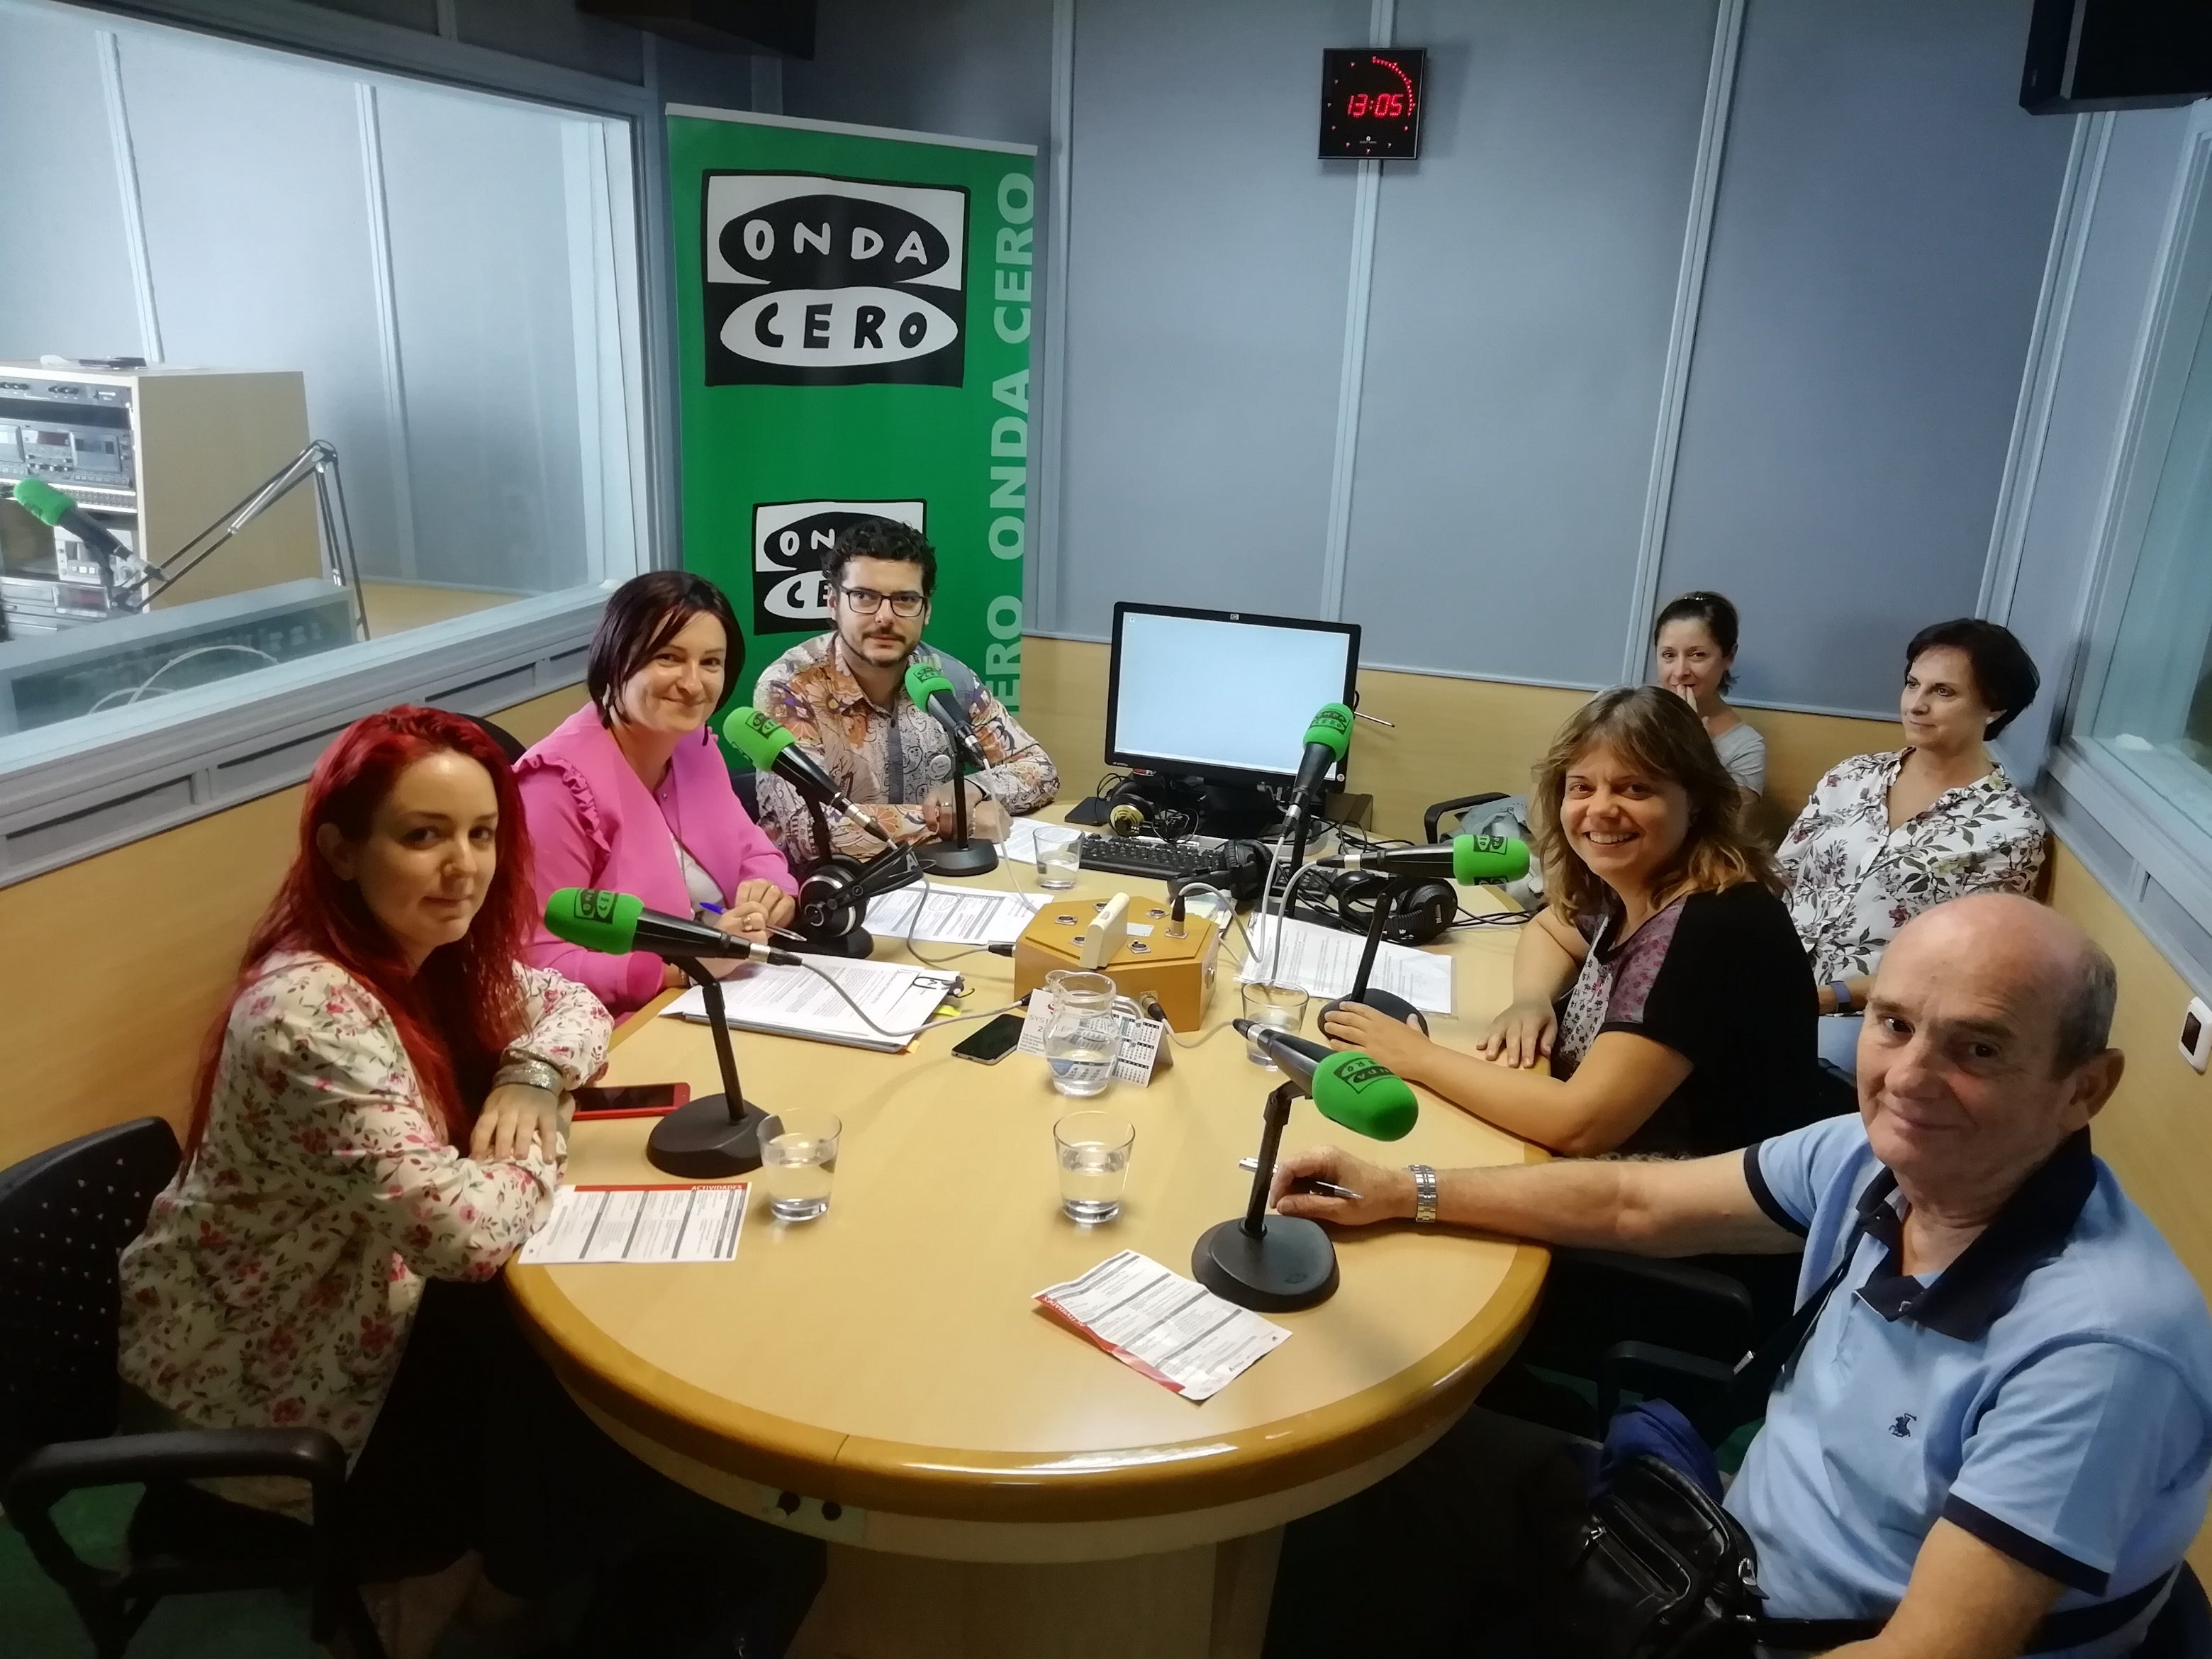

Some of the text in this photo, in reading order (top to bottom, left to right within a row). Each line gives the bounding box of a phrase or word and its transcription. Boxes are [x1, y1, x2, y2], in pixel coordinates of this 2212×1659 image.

[1347, 93, 1404, 118] 13:05
[743, 218, 927, 265] ONDA
[754, 302, 927, 349] CERO
[985, 172, 1034, 716] ERO ONDA CERO
[780, 528, 836, 557] ON
[786, 580, 829, 609] CE
